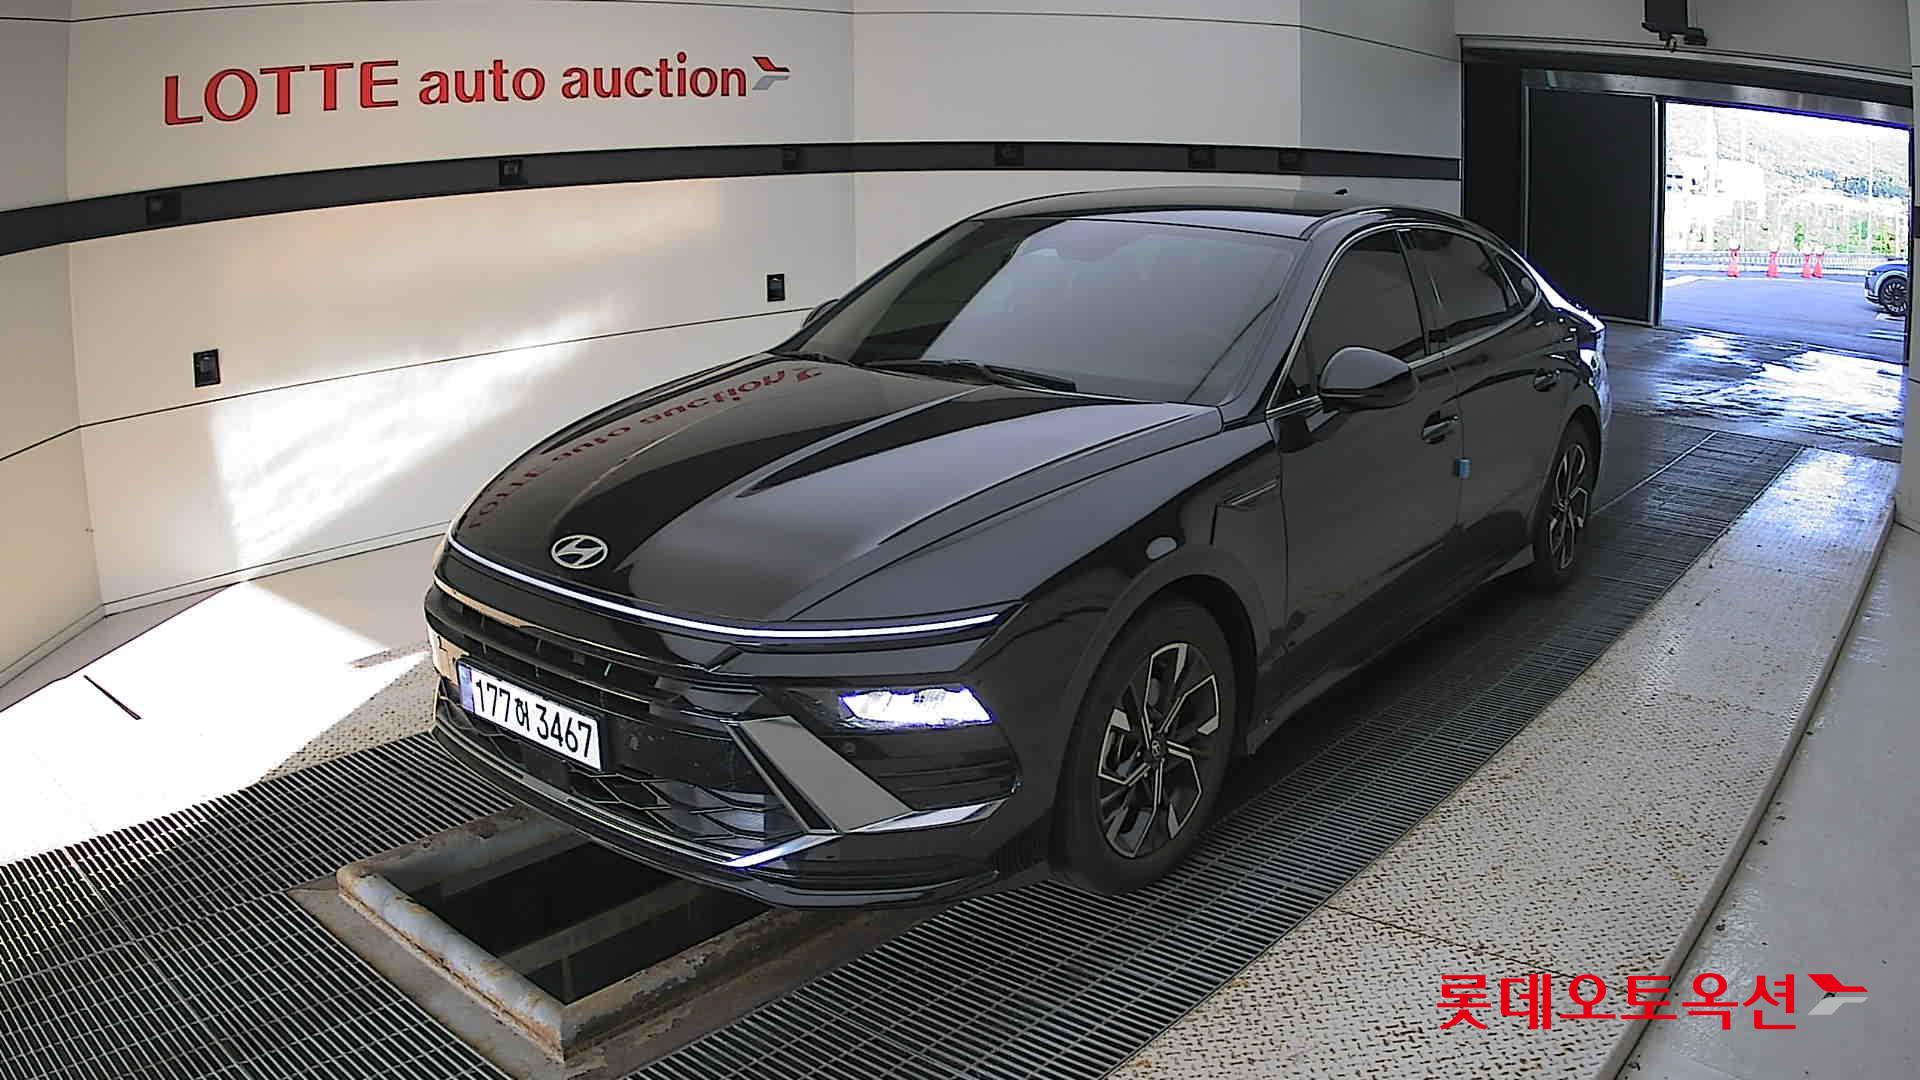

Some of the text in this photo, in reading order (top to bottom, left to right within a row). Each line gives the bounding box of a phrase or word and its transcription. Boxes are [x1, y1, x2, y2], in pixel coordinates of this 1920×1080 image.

[164, 51, 748, 126] LOTTE auto auction
[476, 679, 592, 758] 177허 3467
